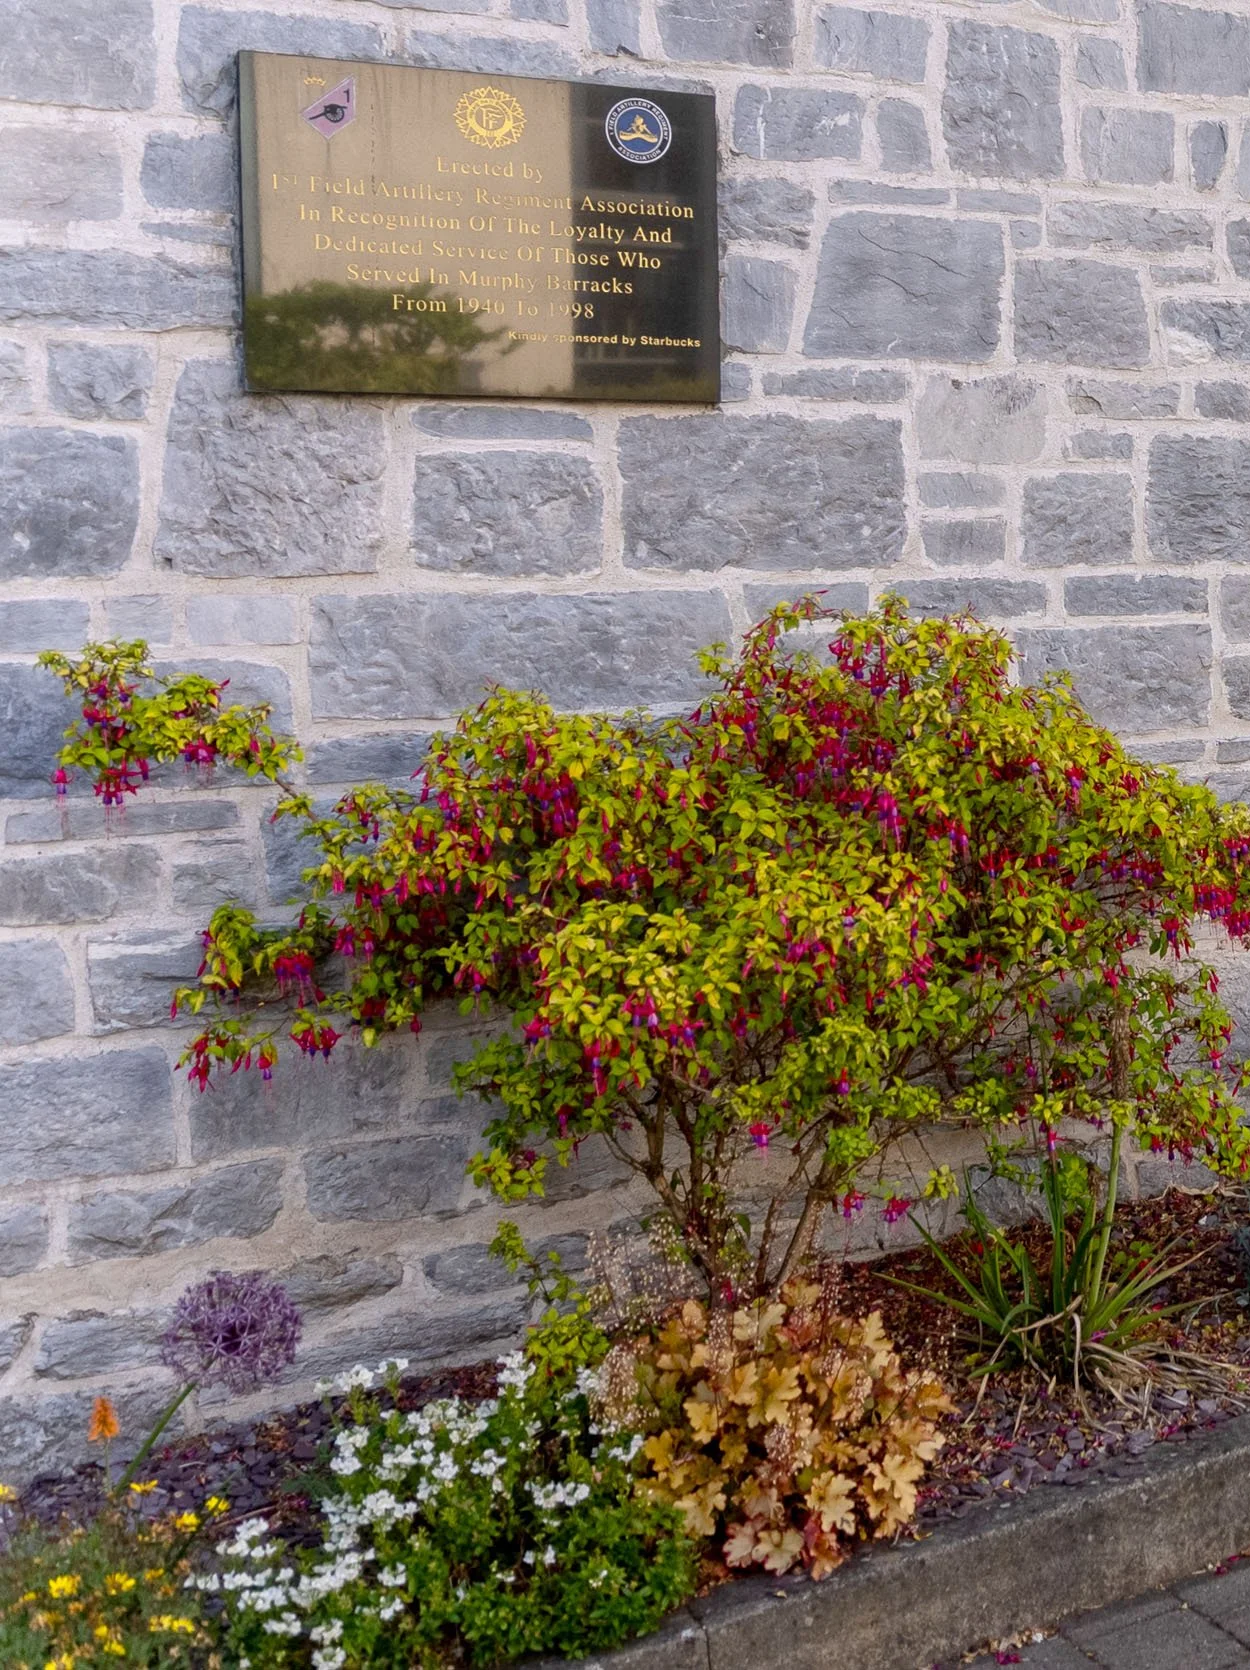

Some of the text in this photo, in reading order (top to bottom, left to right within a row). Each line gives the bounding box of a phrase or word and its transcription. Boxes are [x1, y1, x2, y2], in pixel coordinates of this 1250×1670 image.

[616, 100, 652, 113] ARTILLERY
[617, 146, 662, 161] ASSOCIATION
[436, 157, 544, 183] Erected by
[310, 175, 365, 196] Field
[376, 182, 464, 207] Artillery
[475, 187, 572, 209] Regiment
[580, 195, 694, 218] Association
[299, 204, 672, 244] In Recognition Of The Loyalty And
[315, 233, 661, 269] Dedicated Service Of Those Who
[346, 263, 633, 295] Served In Murphy Barracks
[392, 294, 595, 319] From 1940 To 1998
[508, 330, 701, 348] Kindly sponsored by Starbucks
